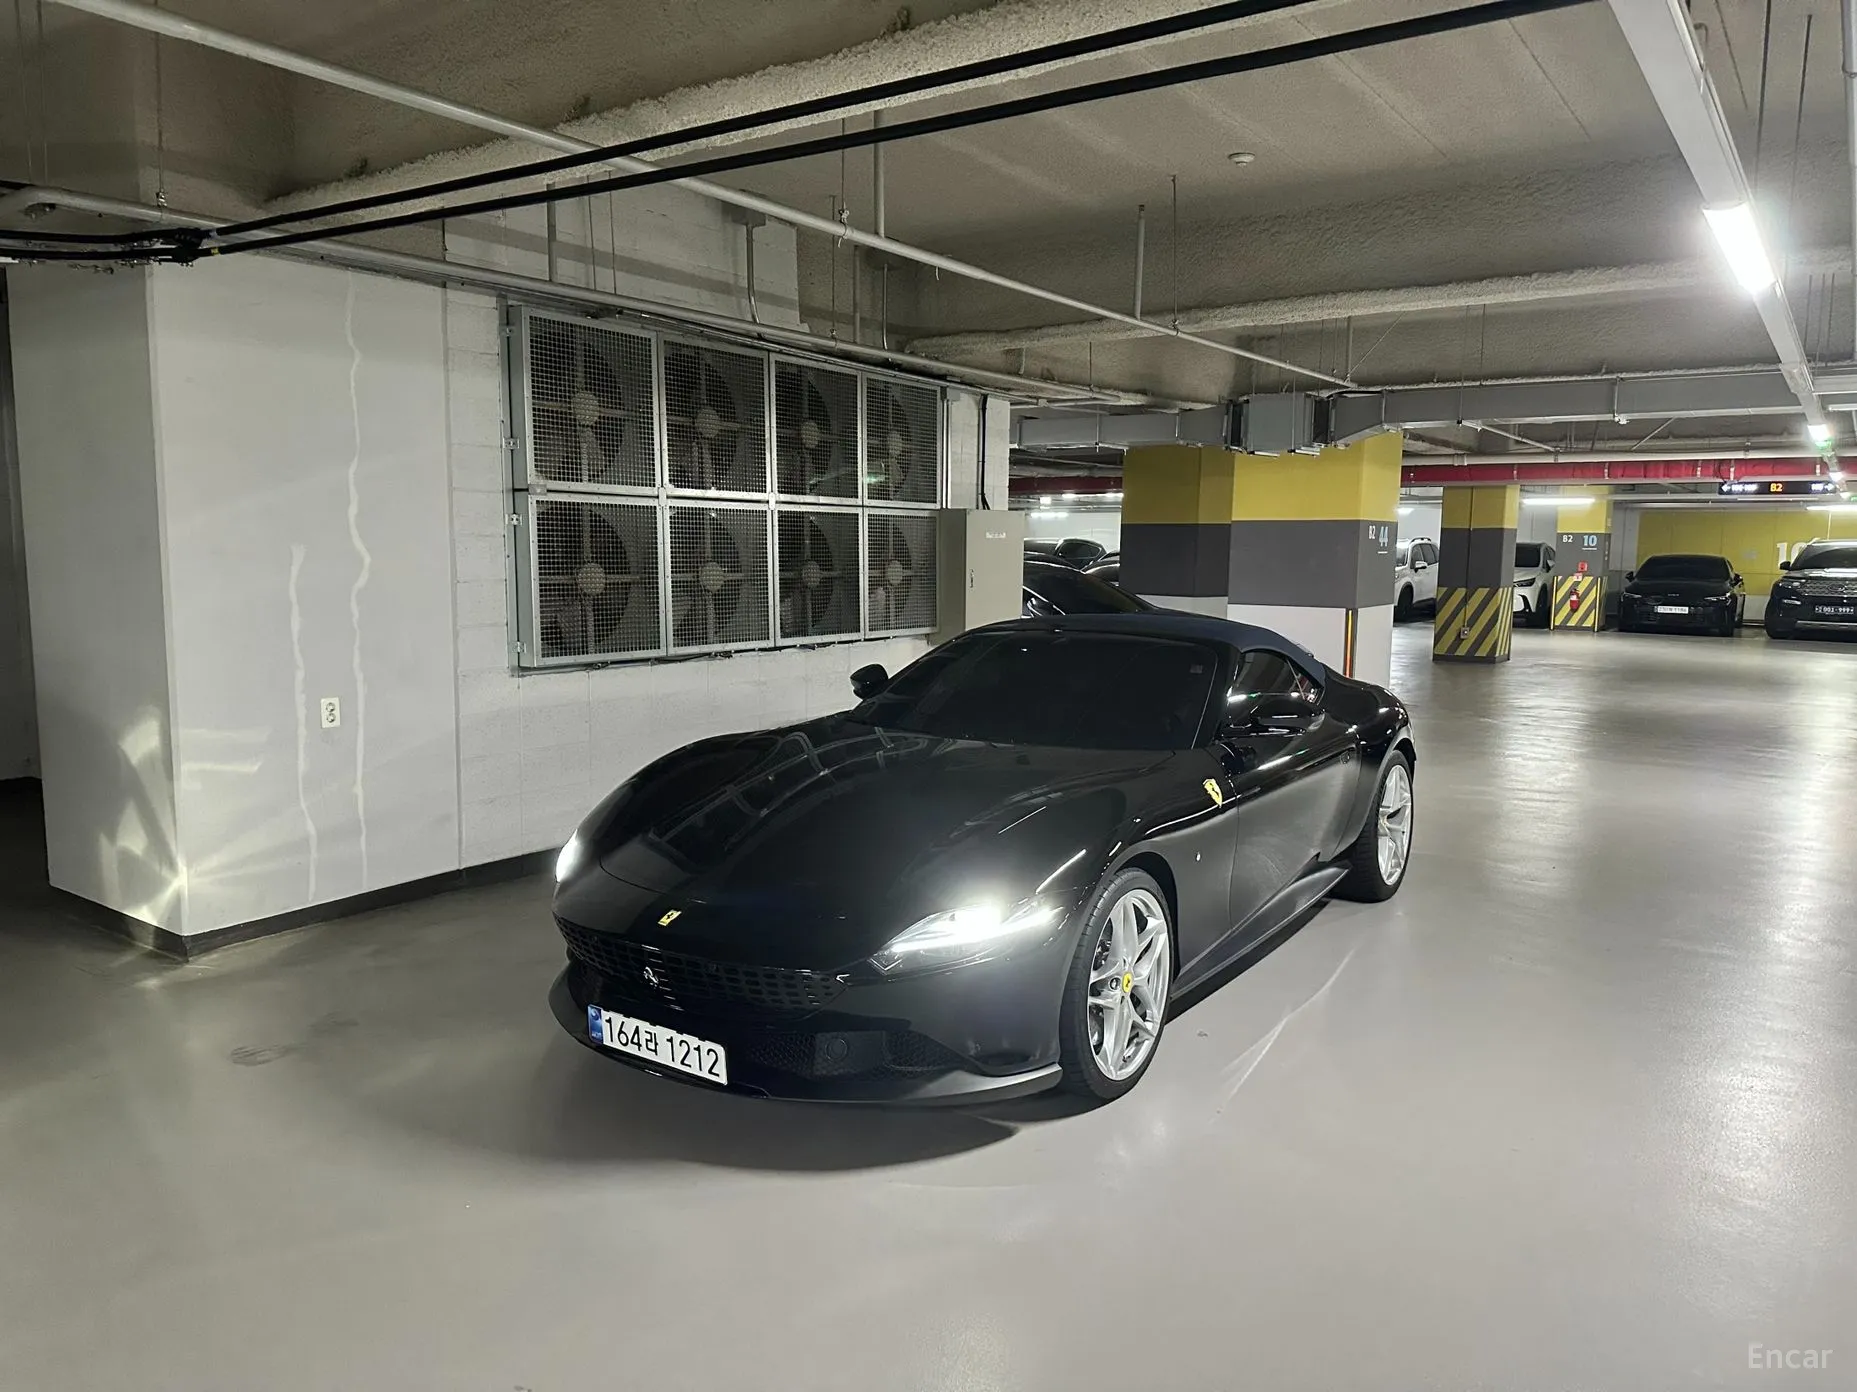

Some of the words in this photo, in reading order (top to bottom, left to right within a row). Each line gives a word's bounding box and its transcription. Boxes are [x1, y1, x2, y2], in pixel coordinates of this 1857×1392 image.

[1369, 525, 1376, 539] B2
[1379, 526, 1388, 547] 44
[1562, 535, 1573, 543] B2
[1583, 535, 1598, 547] 10
[605, 1016, 659, 1056] 164라
[666, 1035, 720, 1078] 1212
